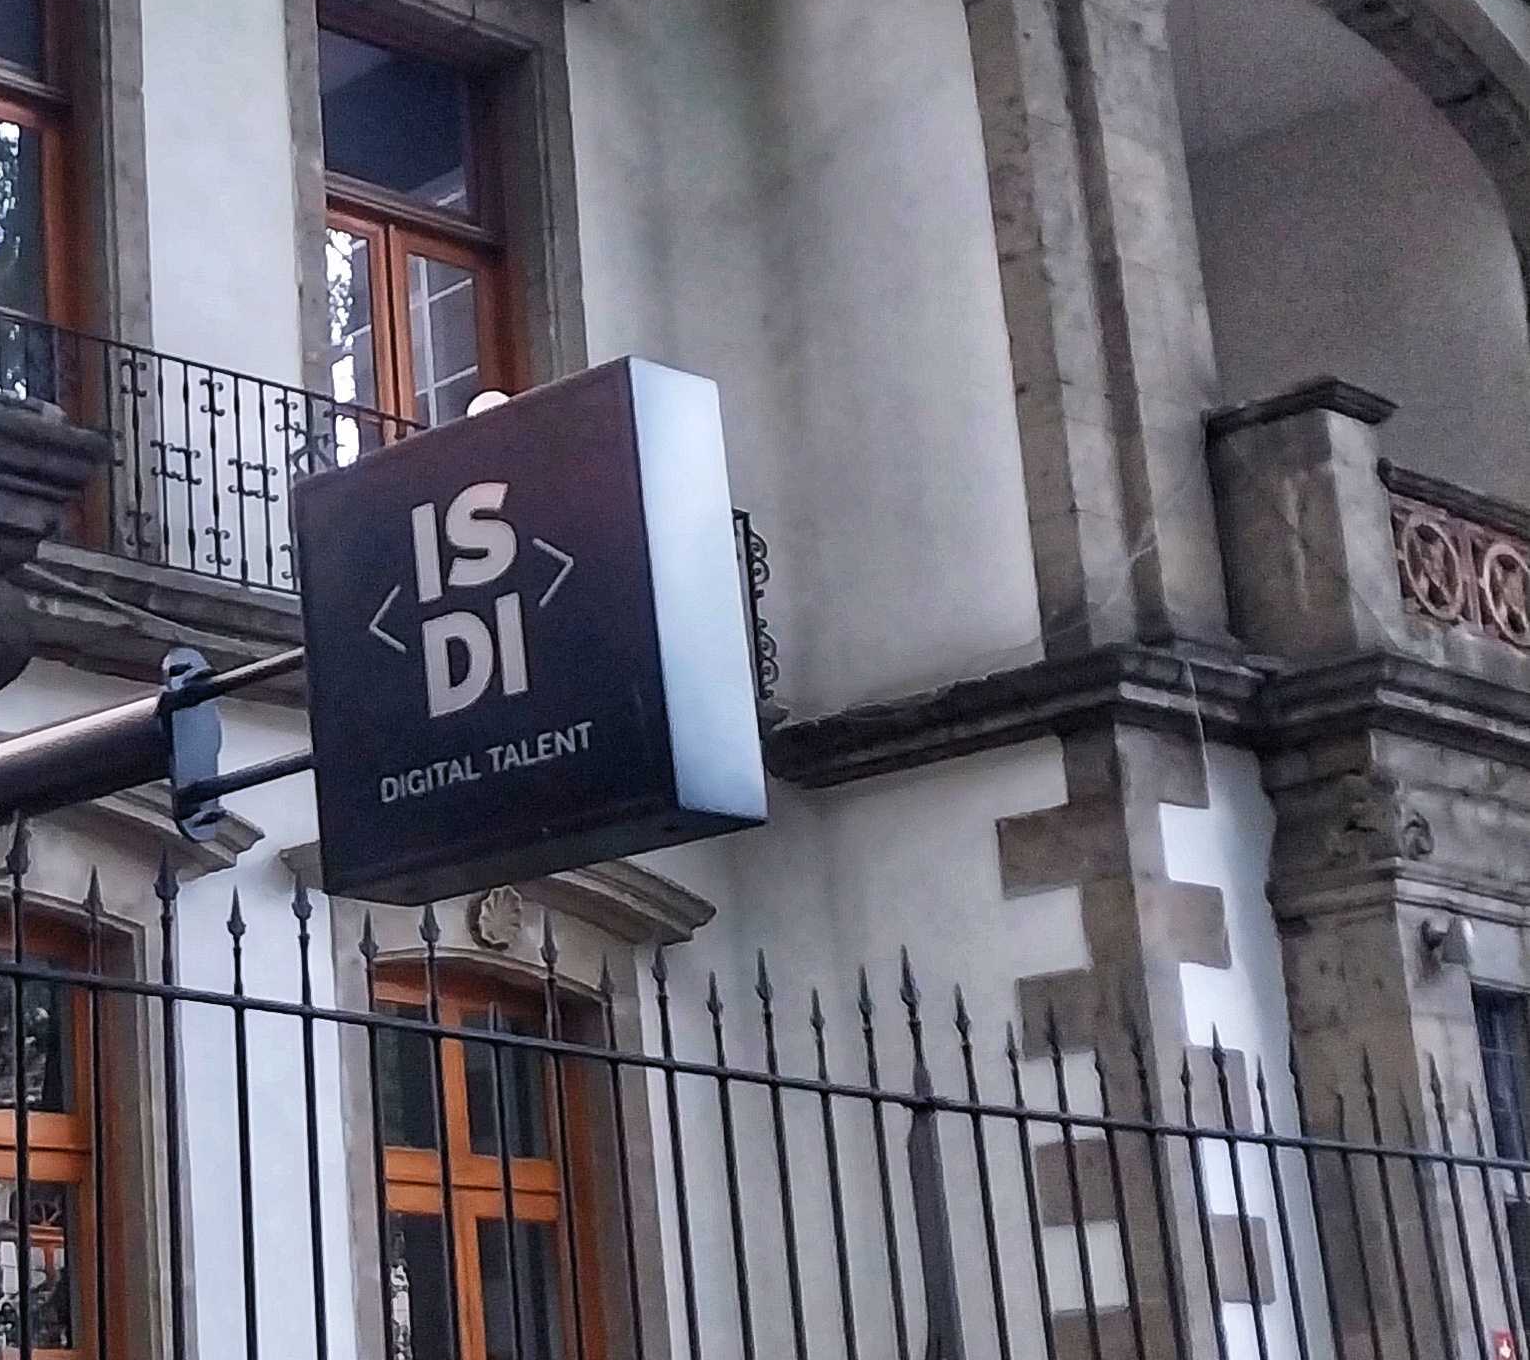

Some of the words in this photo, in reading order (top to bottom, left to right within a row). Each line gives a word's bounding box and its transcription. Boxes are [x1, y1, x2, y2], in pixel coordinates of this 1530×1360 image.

[412, 482, 517, 603] IS
[422, 592, 528, 718] DI
[381, 756, 482, 803] DIGITAL
[486, 722, 593, 772] TALENT
